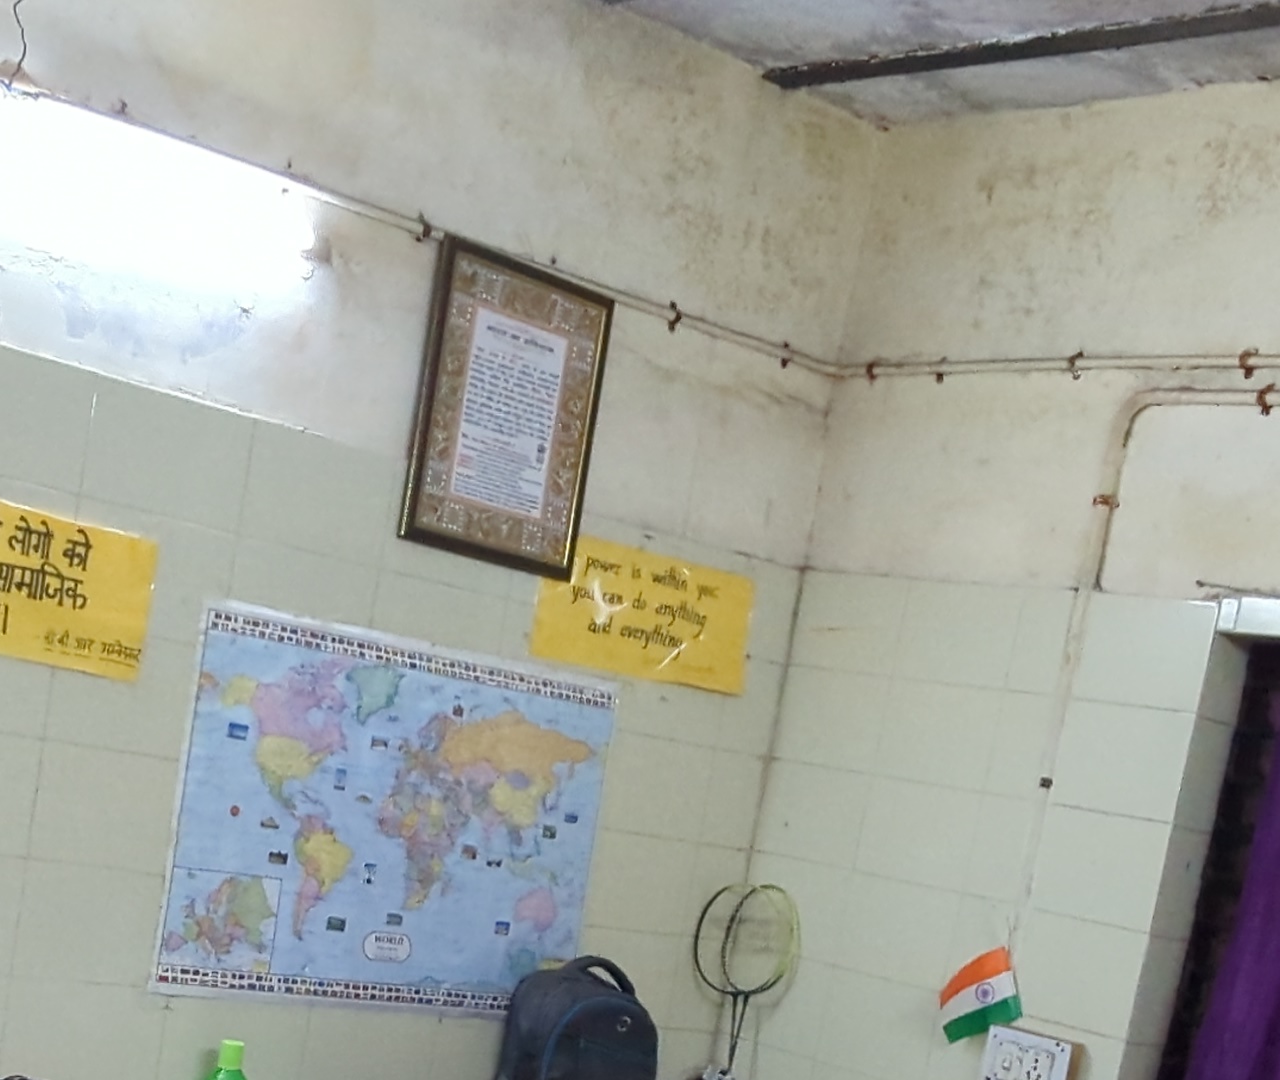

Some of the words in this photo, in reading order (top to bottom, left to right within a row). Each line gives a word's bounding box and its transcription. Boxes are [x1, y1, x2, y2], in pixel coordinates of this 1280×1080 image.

[62, 528, 92, 572] को
[585, 555, 621, 576] power
[632, 563, 641, 579] is
[651, 567, 688, 592] within
[571, 585, 595, 604] you
[632, 592, 647, 611] do
[655, 600, 708, 640] anything
[588, 615, 613, 635] and
[620, 622, 685, 661] everything
